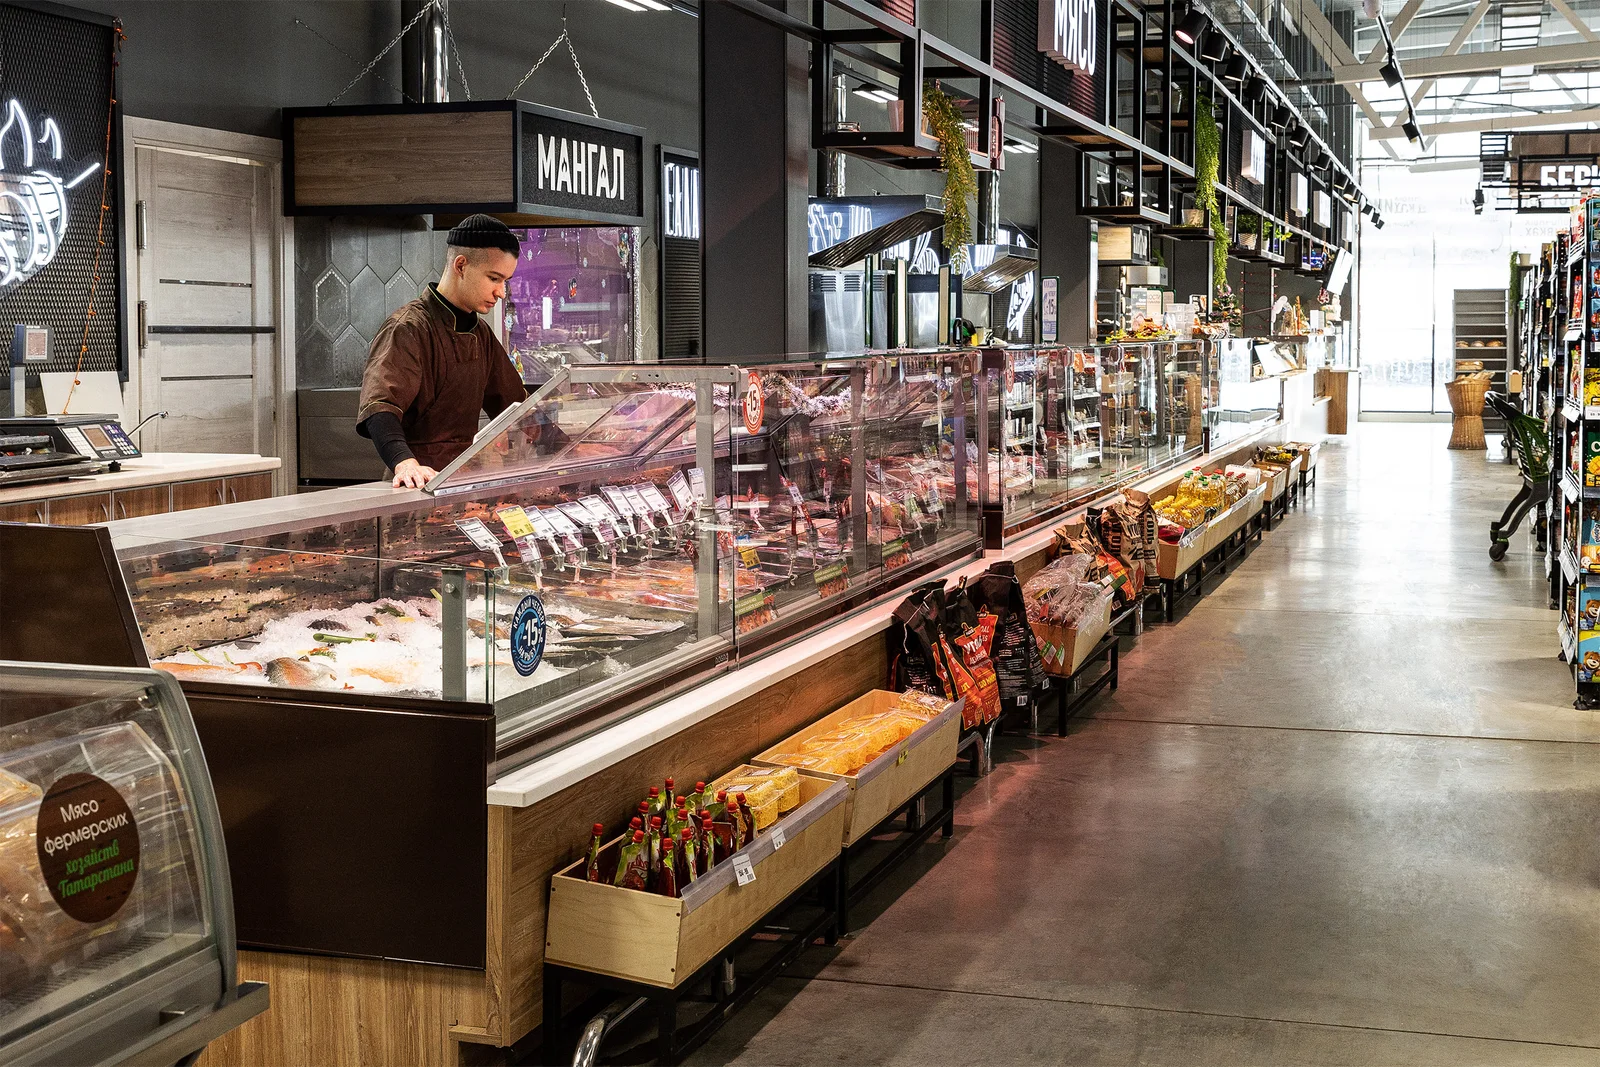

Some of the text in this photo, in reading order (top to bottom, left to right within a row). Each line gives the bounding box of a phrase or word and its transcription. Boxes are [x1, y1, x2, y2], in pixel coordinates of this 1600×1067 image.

[1054, 0, 1097, 76] МЯСО
[537, 133, 625, 201] МАНГАЛ
[60, 799, 100, 824] Мясо
[65, 838, 120, 876] хозяйств
[57, 858, 135, 899] Татарстана
